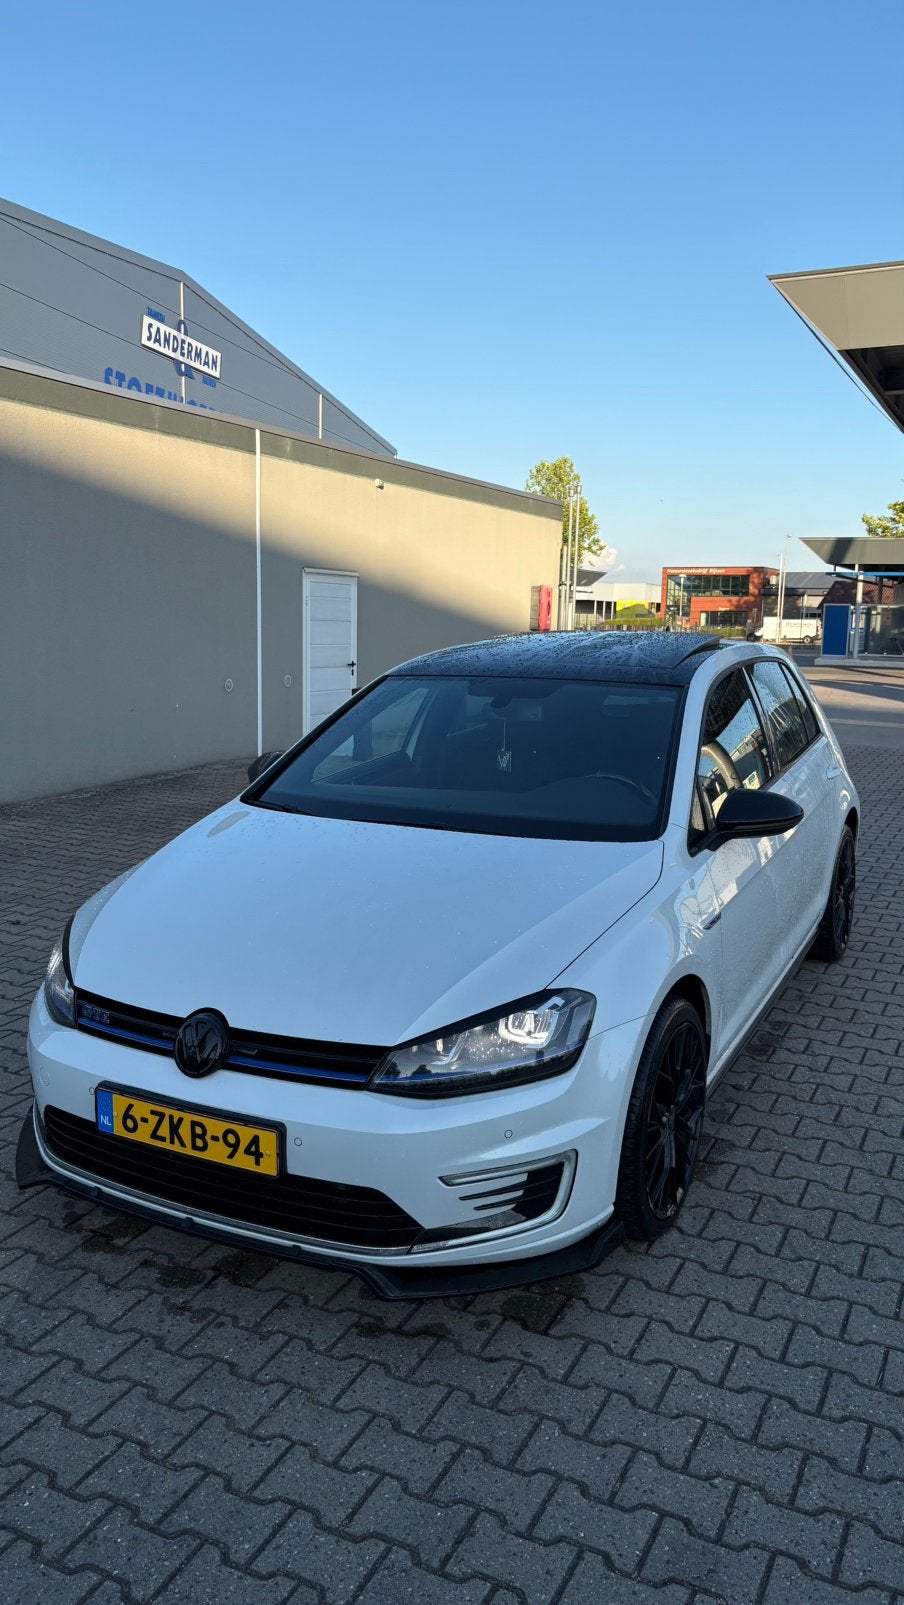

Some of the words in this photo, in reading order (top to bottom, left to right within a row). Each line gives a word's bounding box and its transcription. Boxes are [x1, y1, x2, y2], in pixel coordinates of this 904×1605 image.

[146, 322, 218, 372] SANDERMAN
[100, 1115, 112, 1126] NL
[121, 1103, 264, 1167] 6-ZKB-94
